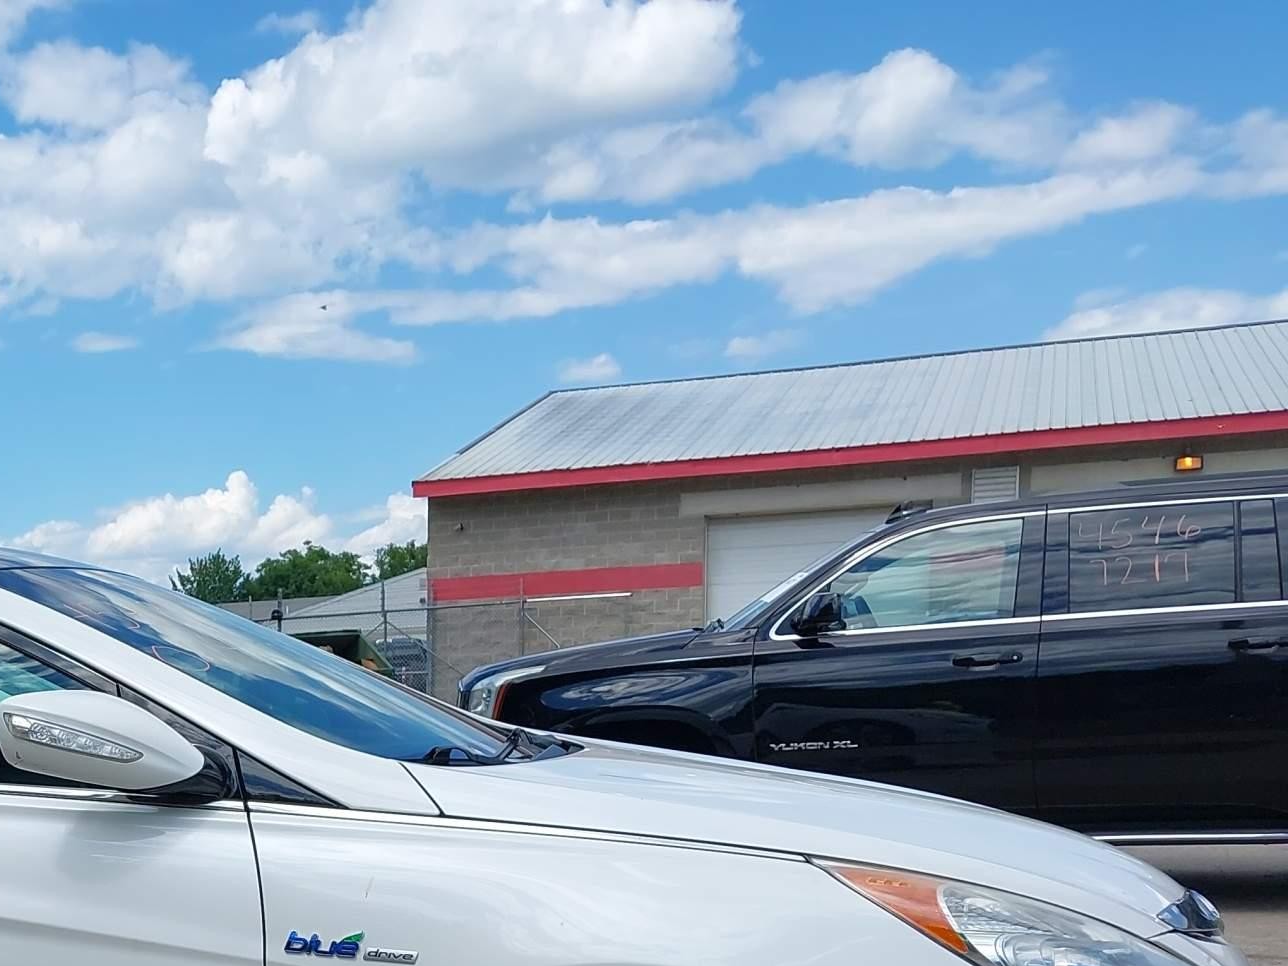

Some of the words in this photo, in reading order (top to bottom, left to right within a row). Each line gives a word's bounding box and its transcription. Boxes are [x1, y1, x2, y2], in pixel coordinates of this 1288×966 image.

[1078, 514, 1201, 550] 4546
[769, 741, 831, 751] YUKON
[832, 740, 859, 749] XL
[283, 930, 364, 958] blue
[367, 949, 414, 961] drive
